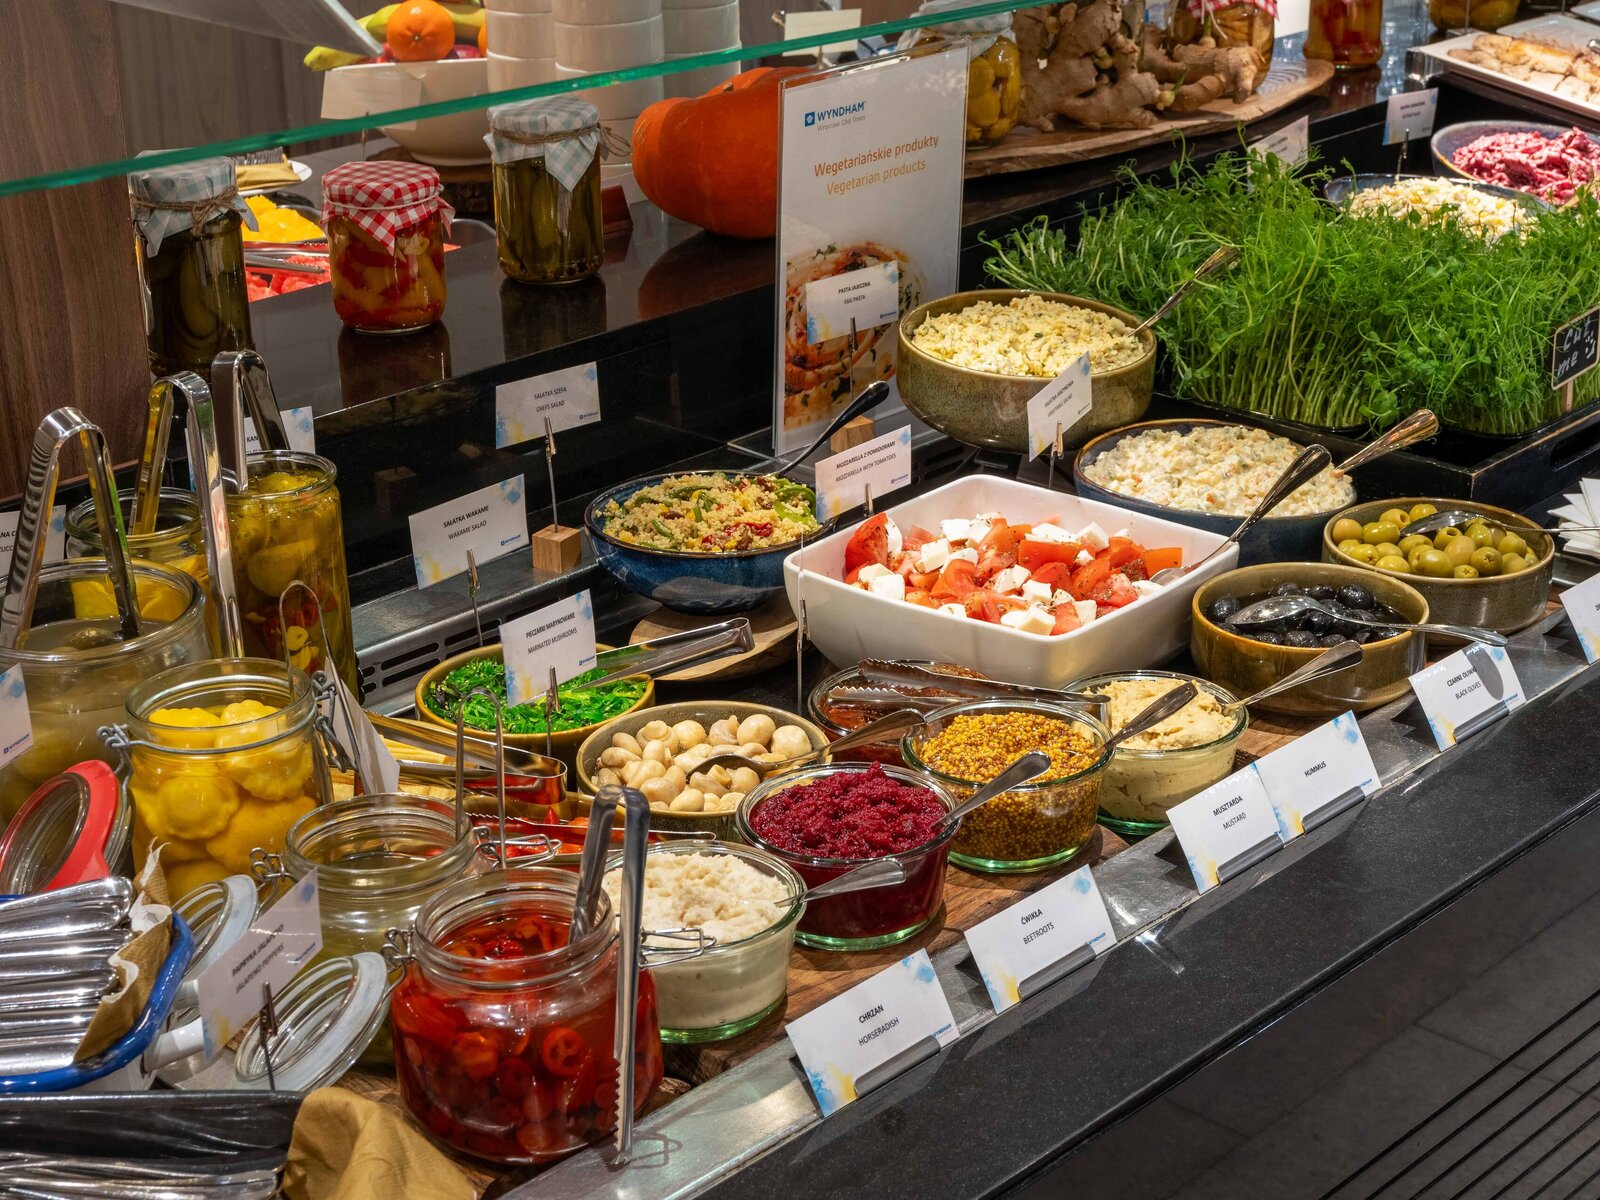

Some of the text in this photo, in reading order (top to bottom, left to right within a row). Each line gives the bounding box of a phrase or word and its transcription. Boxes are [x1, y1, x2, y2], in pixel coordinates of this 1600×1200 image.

[817, 101, 865, 122] WYNDHAM
[814, 136, 940, 177] Wegetariańskie produkty
[826, 159, 926, 195] Vegetarian products
[1557, 351, 1579, 378] me
[551, 400, 565, 409] SALAD
[836, 454, 863, 470] MOZZARELLA
[867, 441, 896, 456] POMIDORAMI
[836, 453, 897, 482] MOZZARELLA WITH TOMATOES
[443, 505, 489, 528] SAŁATKA WAKAME
[448, 520, 487, 540] WAKAME SALAD
[526, 612, 576, 639] PIECZARKI MARYNOWANE
[528, 627, 578, 654] MARINATED MUSHROOMS
[1447, 674, 1463, 687] CZARNE
[1455, 681, 1481, 700] BLACK OLIVES
[1304, 761, 1327, 778] HUMMUS
[1213, 795, 1243, 816] MUSZTARDA
[1222, 812, 1247, 830] MUSTARD
[1020, 908, 1043, 925] ĆWIKŁA
[1023, 922, 1055, 945] BEETROOTS
[858, 1004, 884, 1024] CHRZAN
[858, 1017, 900, 1046] HORSERADISH
